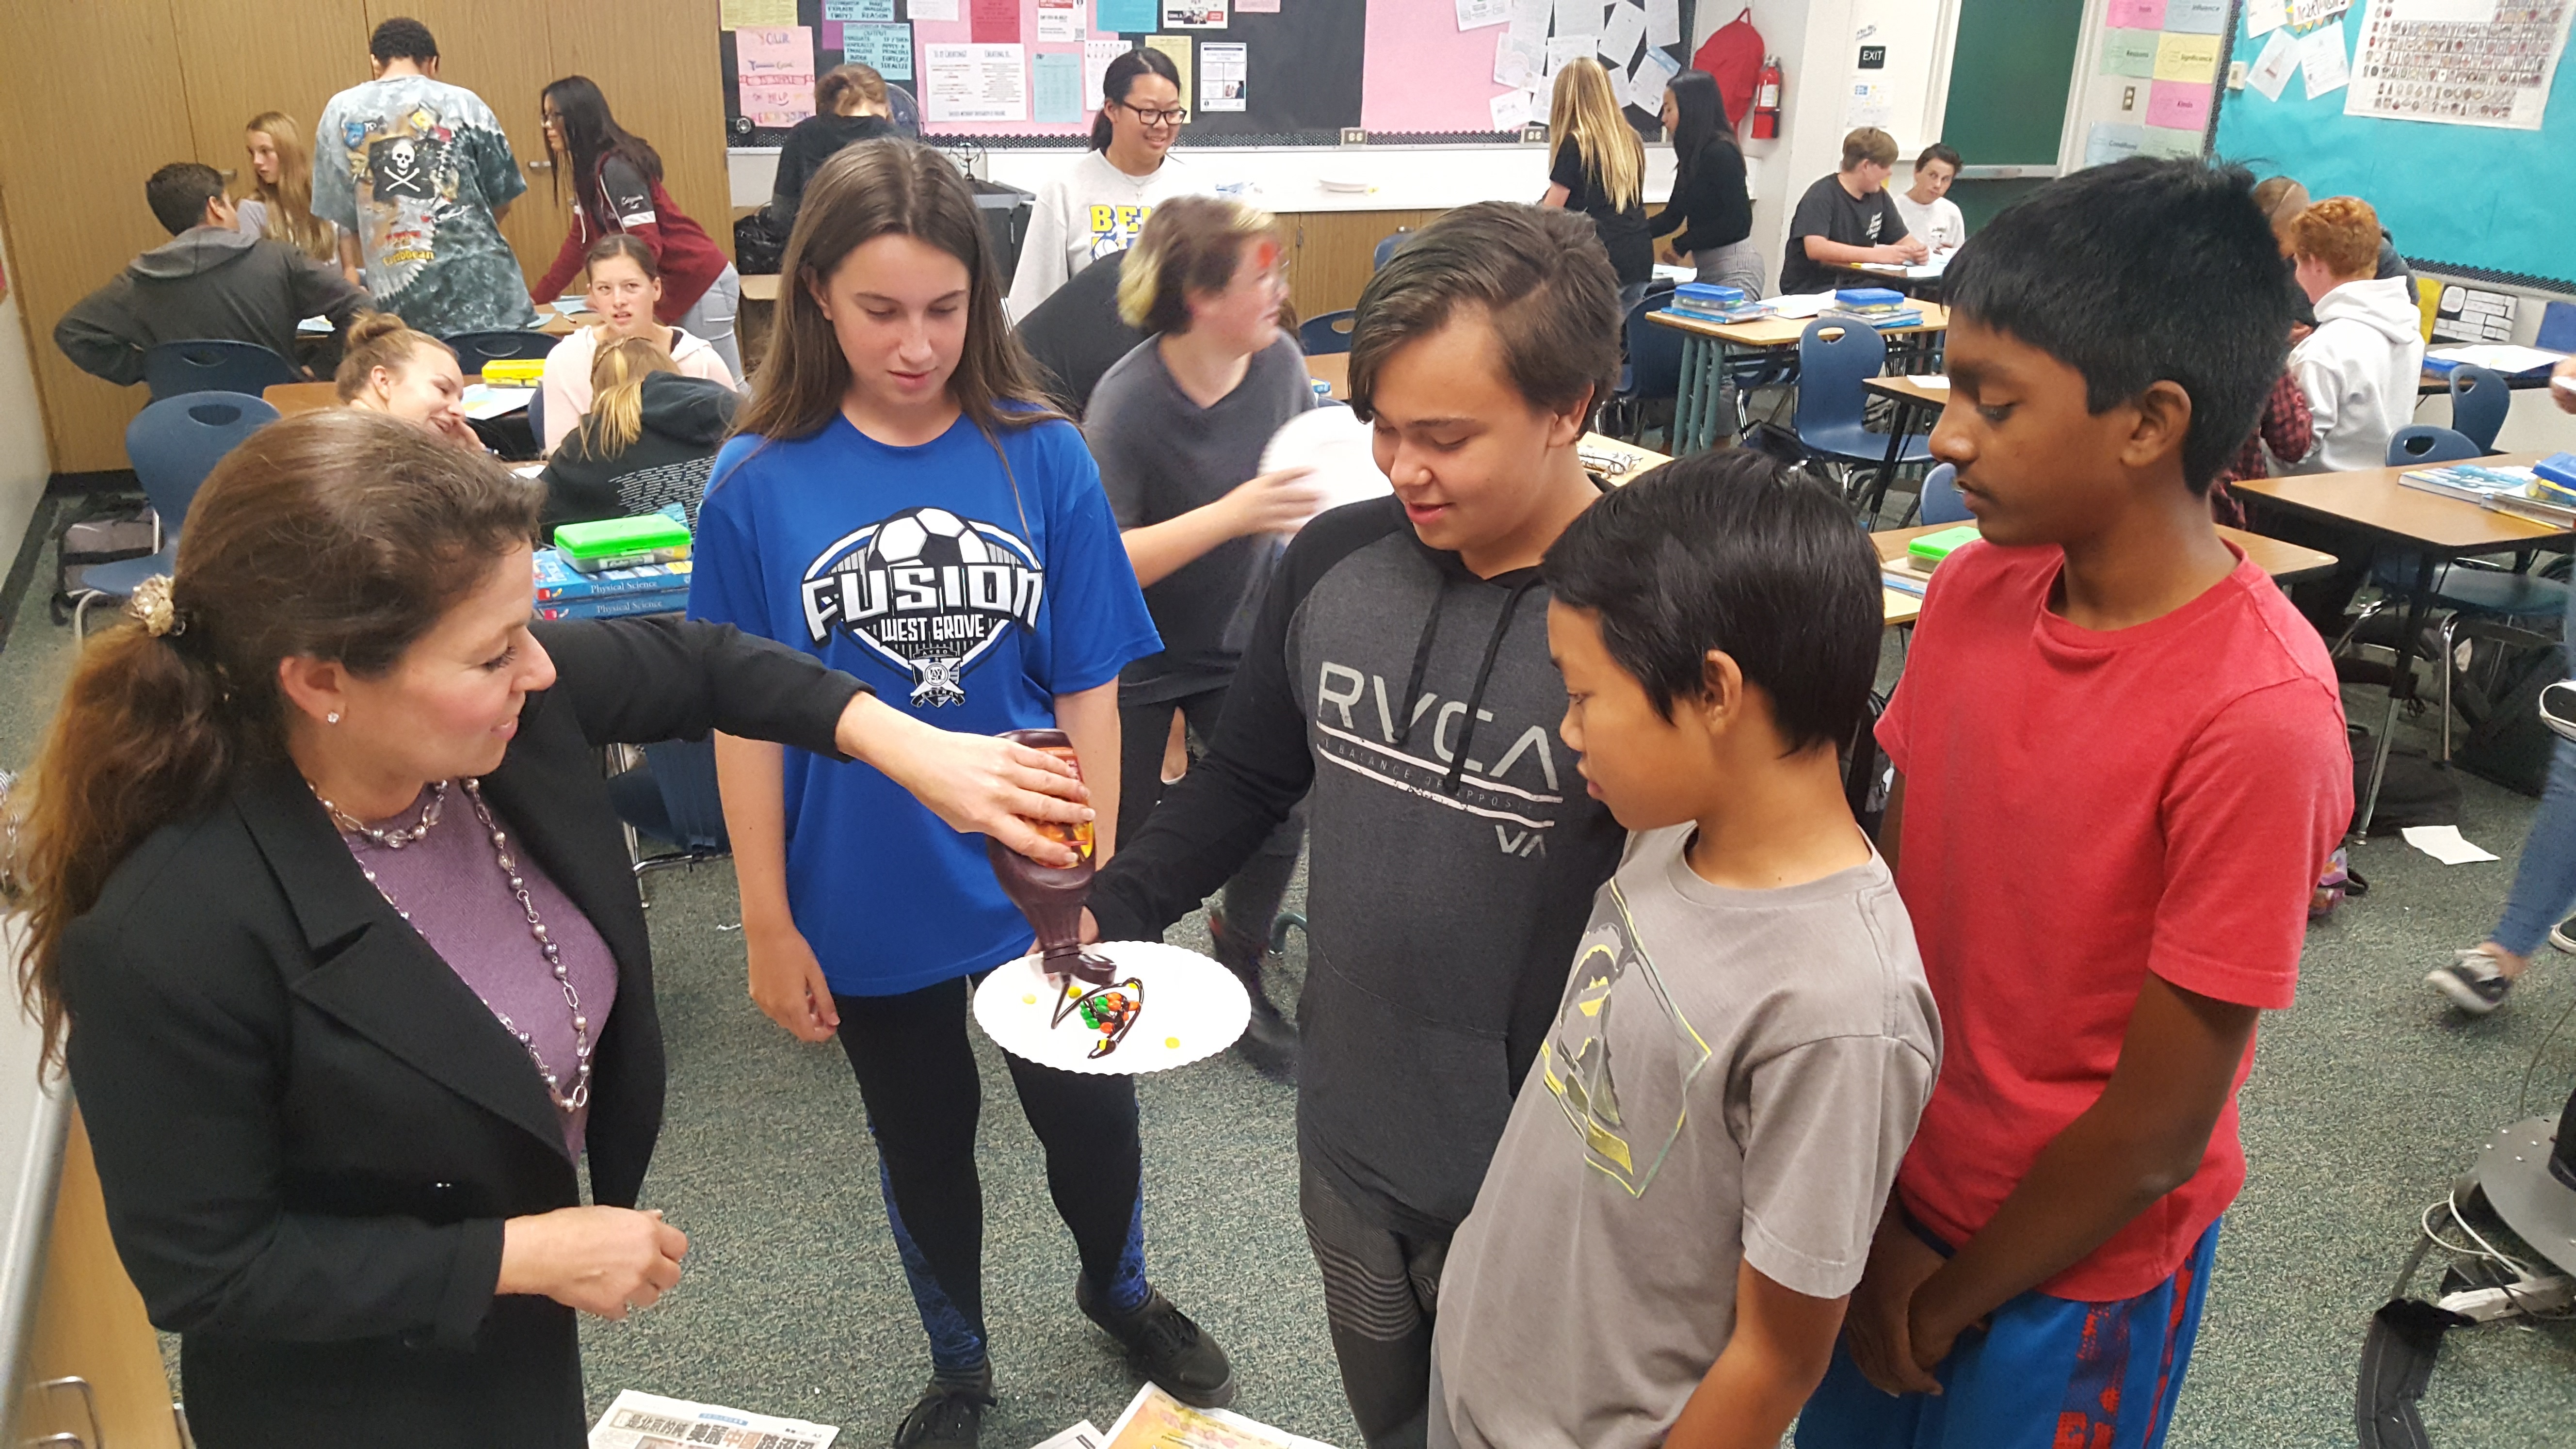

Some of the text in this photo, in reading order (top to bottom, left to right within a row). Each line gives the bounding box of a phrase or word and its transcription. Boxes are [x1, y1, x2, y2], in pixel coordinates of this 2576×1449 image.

[1863, 50, 1883, 60] EXIT
[591, 580, 657, 595] Physical Science
[597, 600, 662, 613] Physical Science
[802, 565, 1044, 642] FUSION
[881, 614, 984, 642] WEST GROVE
[1339, 744, 1411, 779] BALANCE
